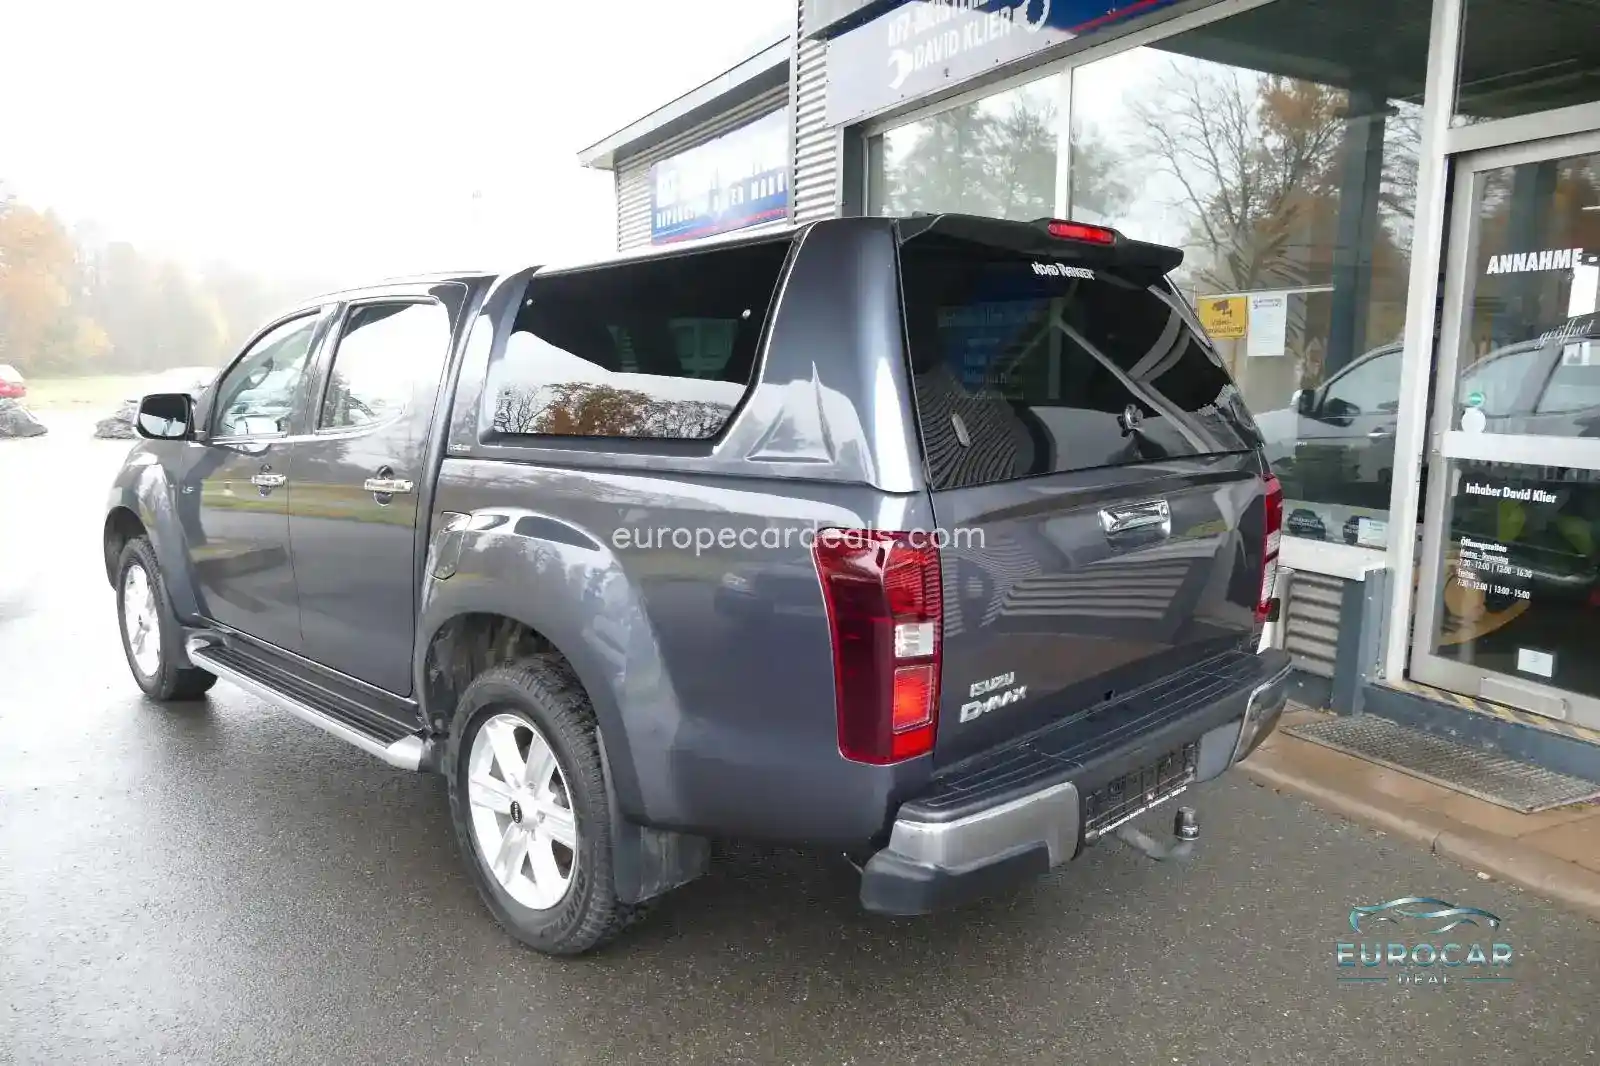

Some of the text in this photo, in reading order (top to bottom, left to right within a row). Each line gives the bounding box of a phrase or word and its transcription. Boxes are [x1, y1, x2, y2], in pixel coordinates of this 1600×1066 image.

[912, 6, 1011, 71] DAVID KLIER
[1486, 248, 1584, 275] ANNAHME
[1465, 482, 1557, 504] Inhaber David Klier
